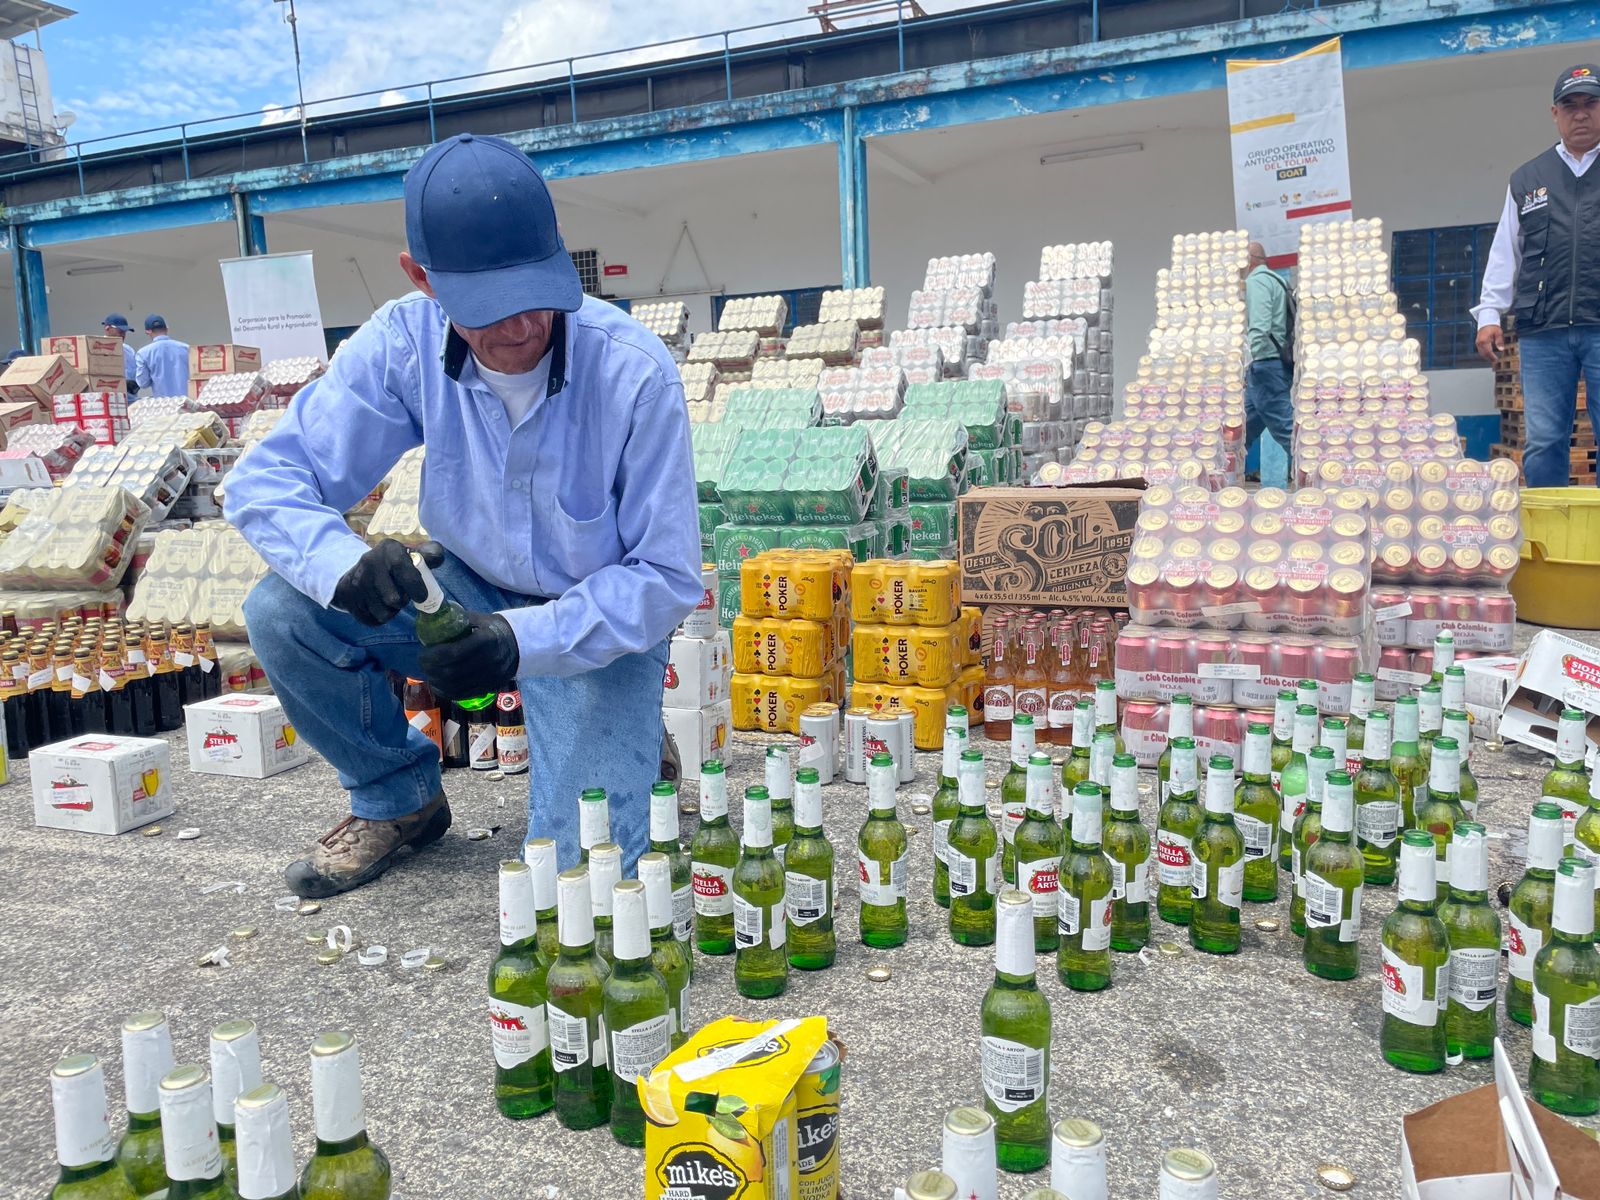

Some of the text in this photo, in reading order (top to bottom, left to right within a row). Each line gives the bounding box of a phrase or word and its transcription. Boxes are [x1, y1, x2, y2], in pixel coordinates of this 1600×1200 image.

[1248, 138, 1334, 159] GRUPO OPERATIVO
[1244, 145, 1335, 168] ANTICONTRABANDO
[1264, 156, 1318, 171] DEL TOLIMA
[1279, 168, 1304, 179] GOAT
[911, 531, 941, 541] neken
[1105, 535, 1131, 548] 1899
[718, 559, 742, 571] Hein
[965, 555, 997, 569] DESDE
[1050, 561, 1099, 579] CERVEZA
[1052, 580, 1092, 593] ORIGINAL
[778, 576, 788, 611] POKER
[894, 580, 903, 615] POKER
[1441, 622, 1487, 632] Club Colombia
[768, 633, 777, 671] POKER
[898, 638, 909, 677] POKER
[1572, 661, 1600, 676] RTOIS
[1145, 673, 1195, 684] Club Colombia
[1263, 677, 1300, 687] Club Colo
[1570, 668, 1600, 685] TELLA
[768, 691, 777, 728] POKER
[1151, 732, 1167, 742] Club
[1158, 845, 1184, 858] STELLA
[1158, 852, 1185, 864] ARTOIS
[694, 877, 720, 888] STELLA
[1037, 874, 1058, 882] STELL
[694, 884, 720, 894] ARTOIS
[1037, 881, 1058, 889] ARTO
[798, 1114, 838, 1150] ike's
[666, 1160, 736, 1188] mike's
[668, 1189, 690, 1198] HARD
